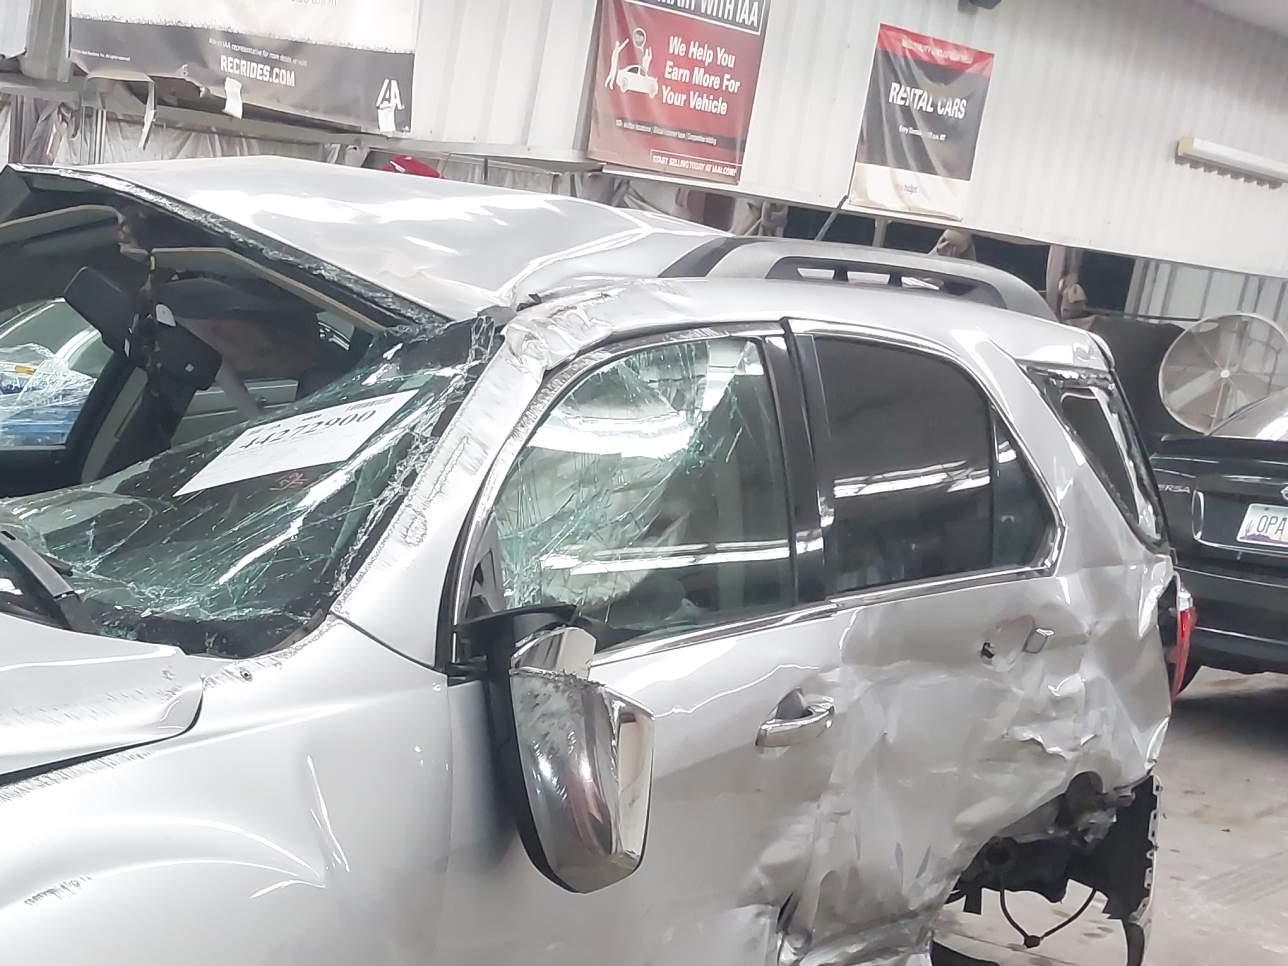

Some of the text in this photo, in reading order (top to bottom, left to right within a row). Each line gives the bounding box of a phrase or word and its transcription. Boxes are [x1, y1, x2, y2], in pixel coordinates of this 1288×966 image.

[735, 0, 759, 28] IAA
[669, 35, 736, 68] We Help You
[220, 54, 295, 87] RECRIDES.COM
[664, 60, 741, 94] Earn More For
[662, 84, 728, 115] Your Vehicle
[888, 81, 967, 119] RENTAL CARS
[239, 409, 376, 438] 44272900
